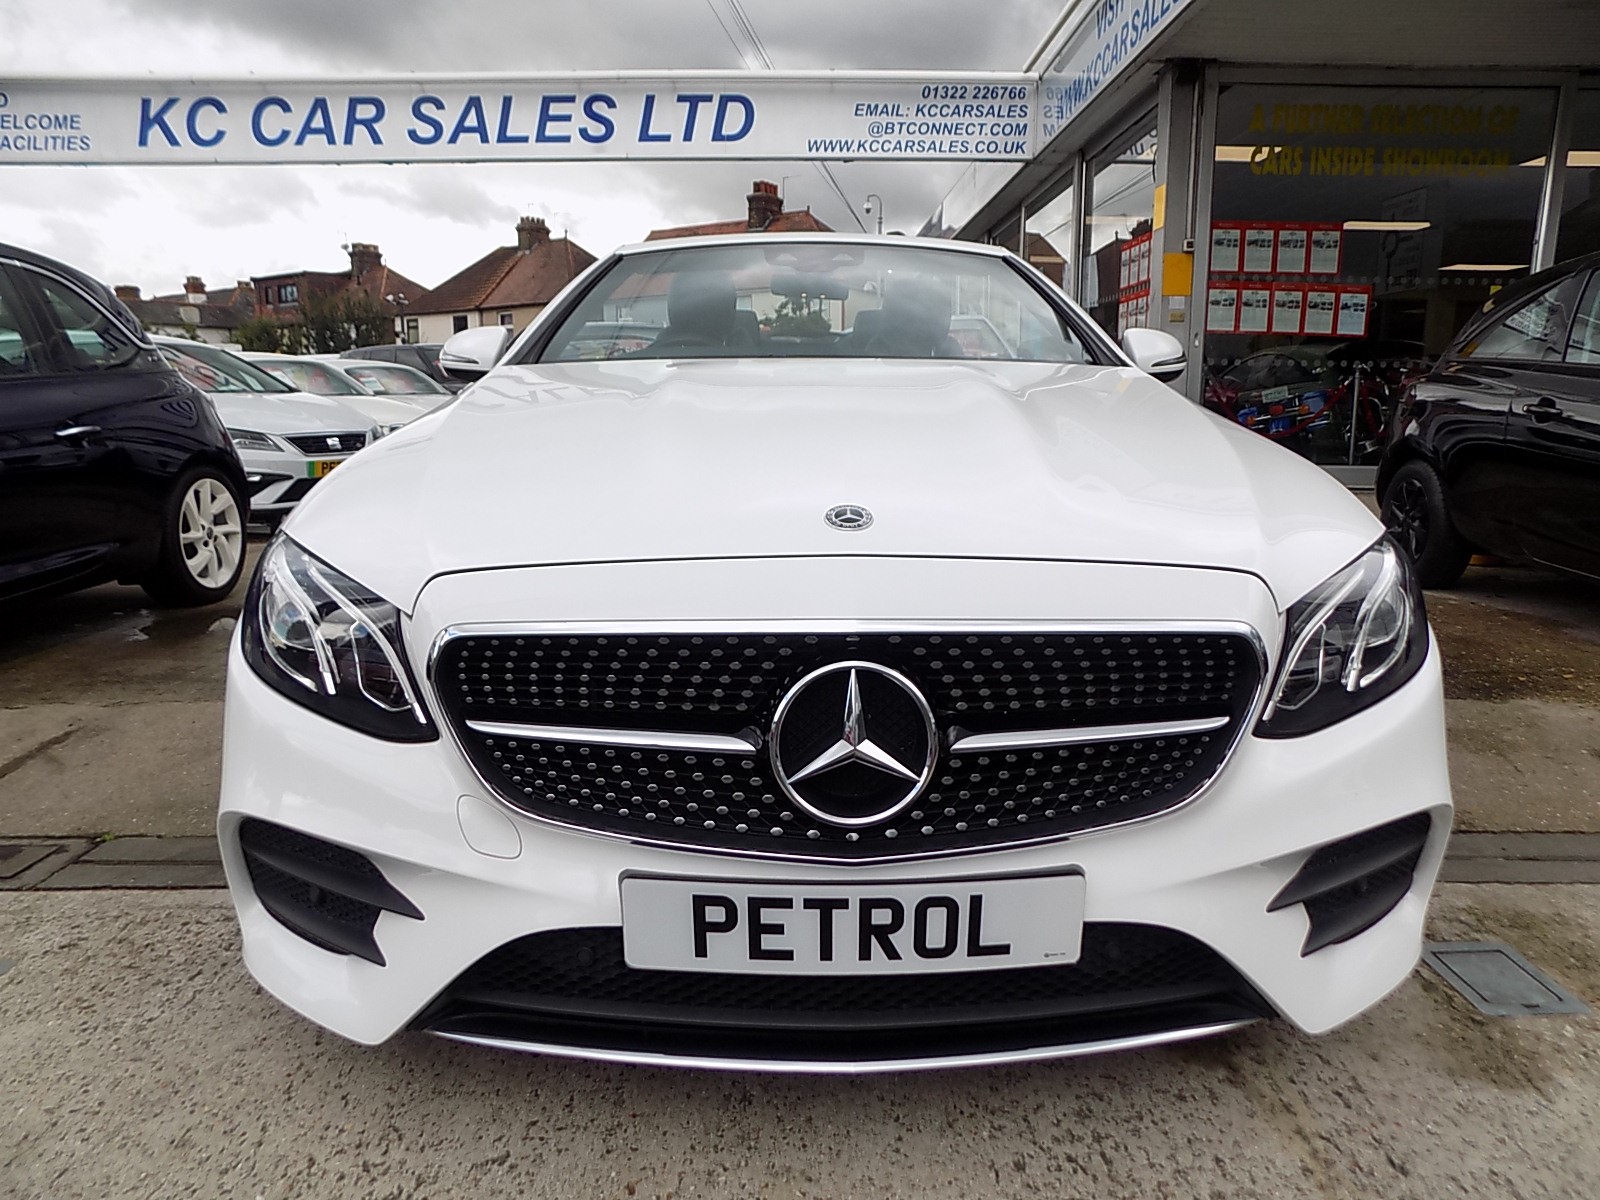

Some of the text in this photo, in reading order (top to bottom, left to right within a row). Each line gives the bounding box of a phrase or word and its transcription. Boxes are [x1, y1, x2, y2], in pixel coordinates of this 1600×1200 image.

[1057, 0, 1179, 123] WWW.KCCARSALE
[921, 85, 1027, 100] 01322 226766
[138, 93, 755, 147] KC CAR SALES LTD
[854, 104, 910, 118] EMAIL:
[915, 104, 1029, 119] KCCARSALES
[1248, 103, 1521, 135] A FURTHER SELECTION OF
[867, 121, 1028, 138] @BTCONNECT.COM
[807, 139, 1027, 155] WWW.KCCARSALES.CO.UK
[1250, 145, 1511, 177] CARS INSIDE SHOWROOM
[691, 893, 1012, 962] PETROL
